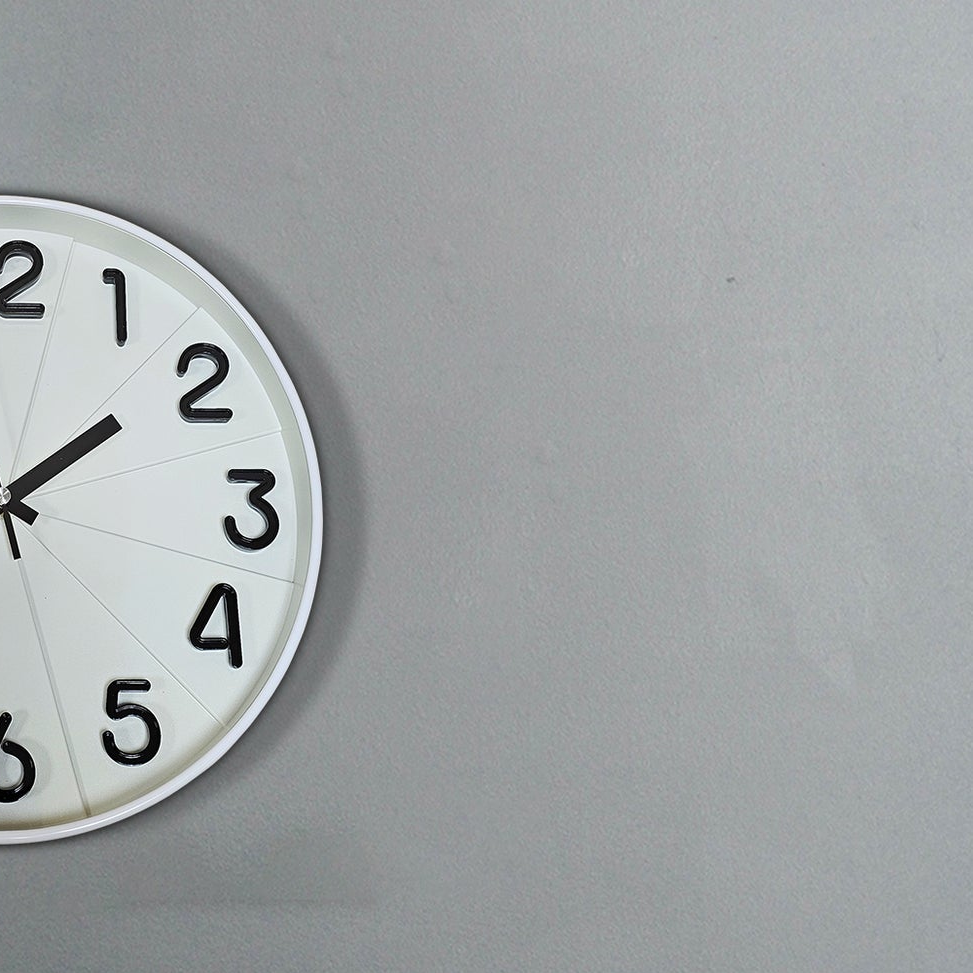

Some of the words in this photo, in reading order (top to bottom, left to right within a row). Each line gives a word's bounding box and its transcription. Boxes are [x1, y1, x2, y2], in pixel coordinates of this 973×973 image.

[102, 268, 127, 346] 1
[176, 342, 234, 423] 2
[224, 468, 281, 552] 3
[188, 582, 244, 668] 4
[101, 678, 162, 768] 5
